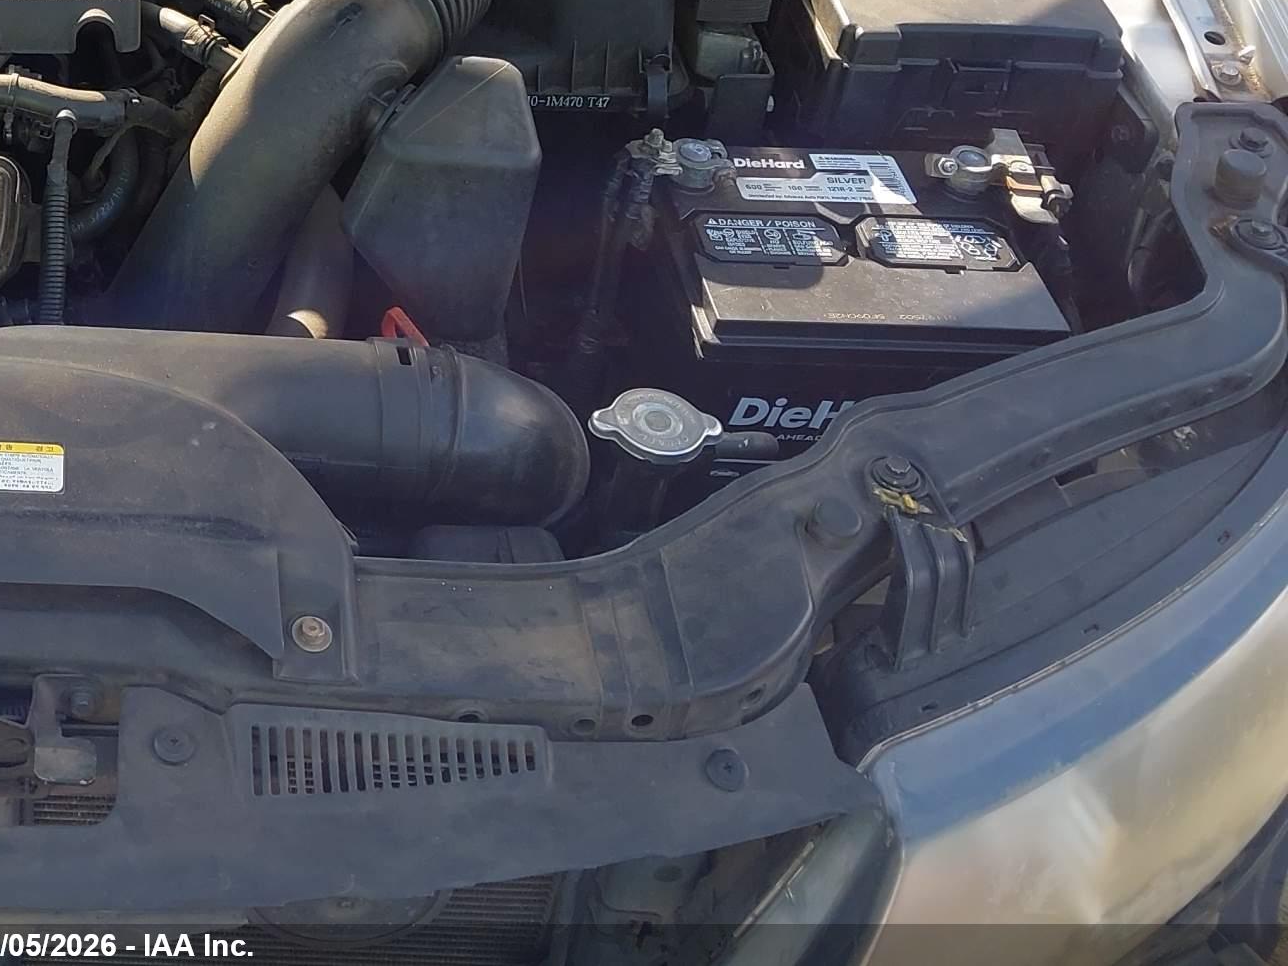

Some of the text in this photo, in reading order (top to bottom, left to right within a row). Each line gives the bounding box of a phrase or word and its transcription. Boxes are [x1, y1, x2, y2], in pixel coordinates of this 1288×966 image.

[587, 96, 610, 108] T47
[733, 157, 805, 170] DieHard
[826, 176, 867, 185] SILVER
[718, 218, 764, 227] DANGER
[774, 220, 816, 228] POISON
